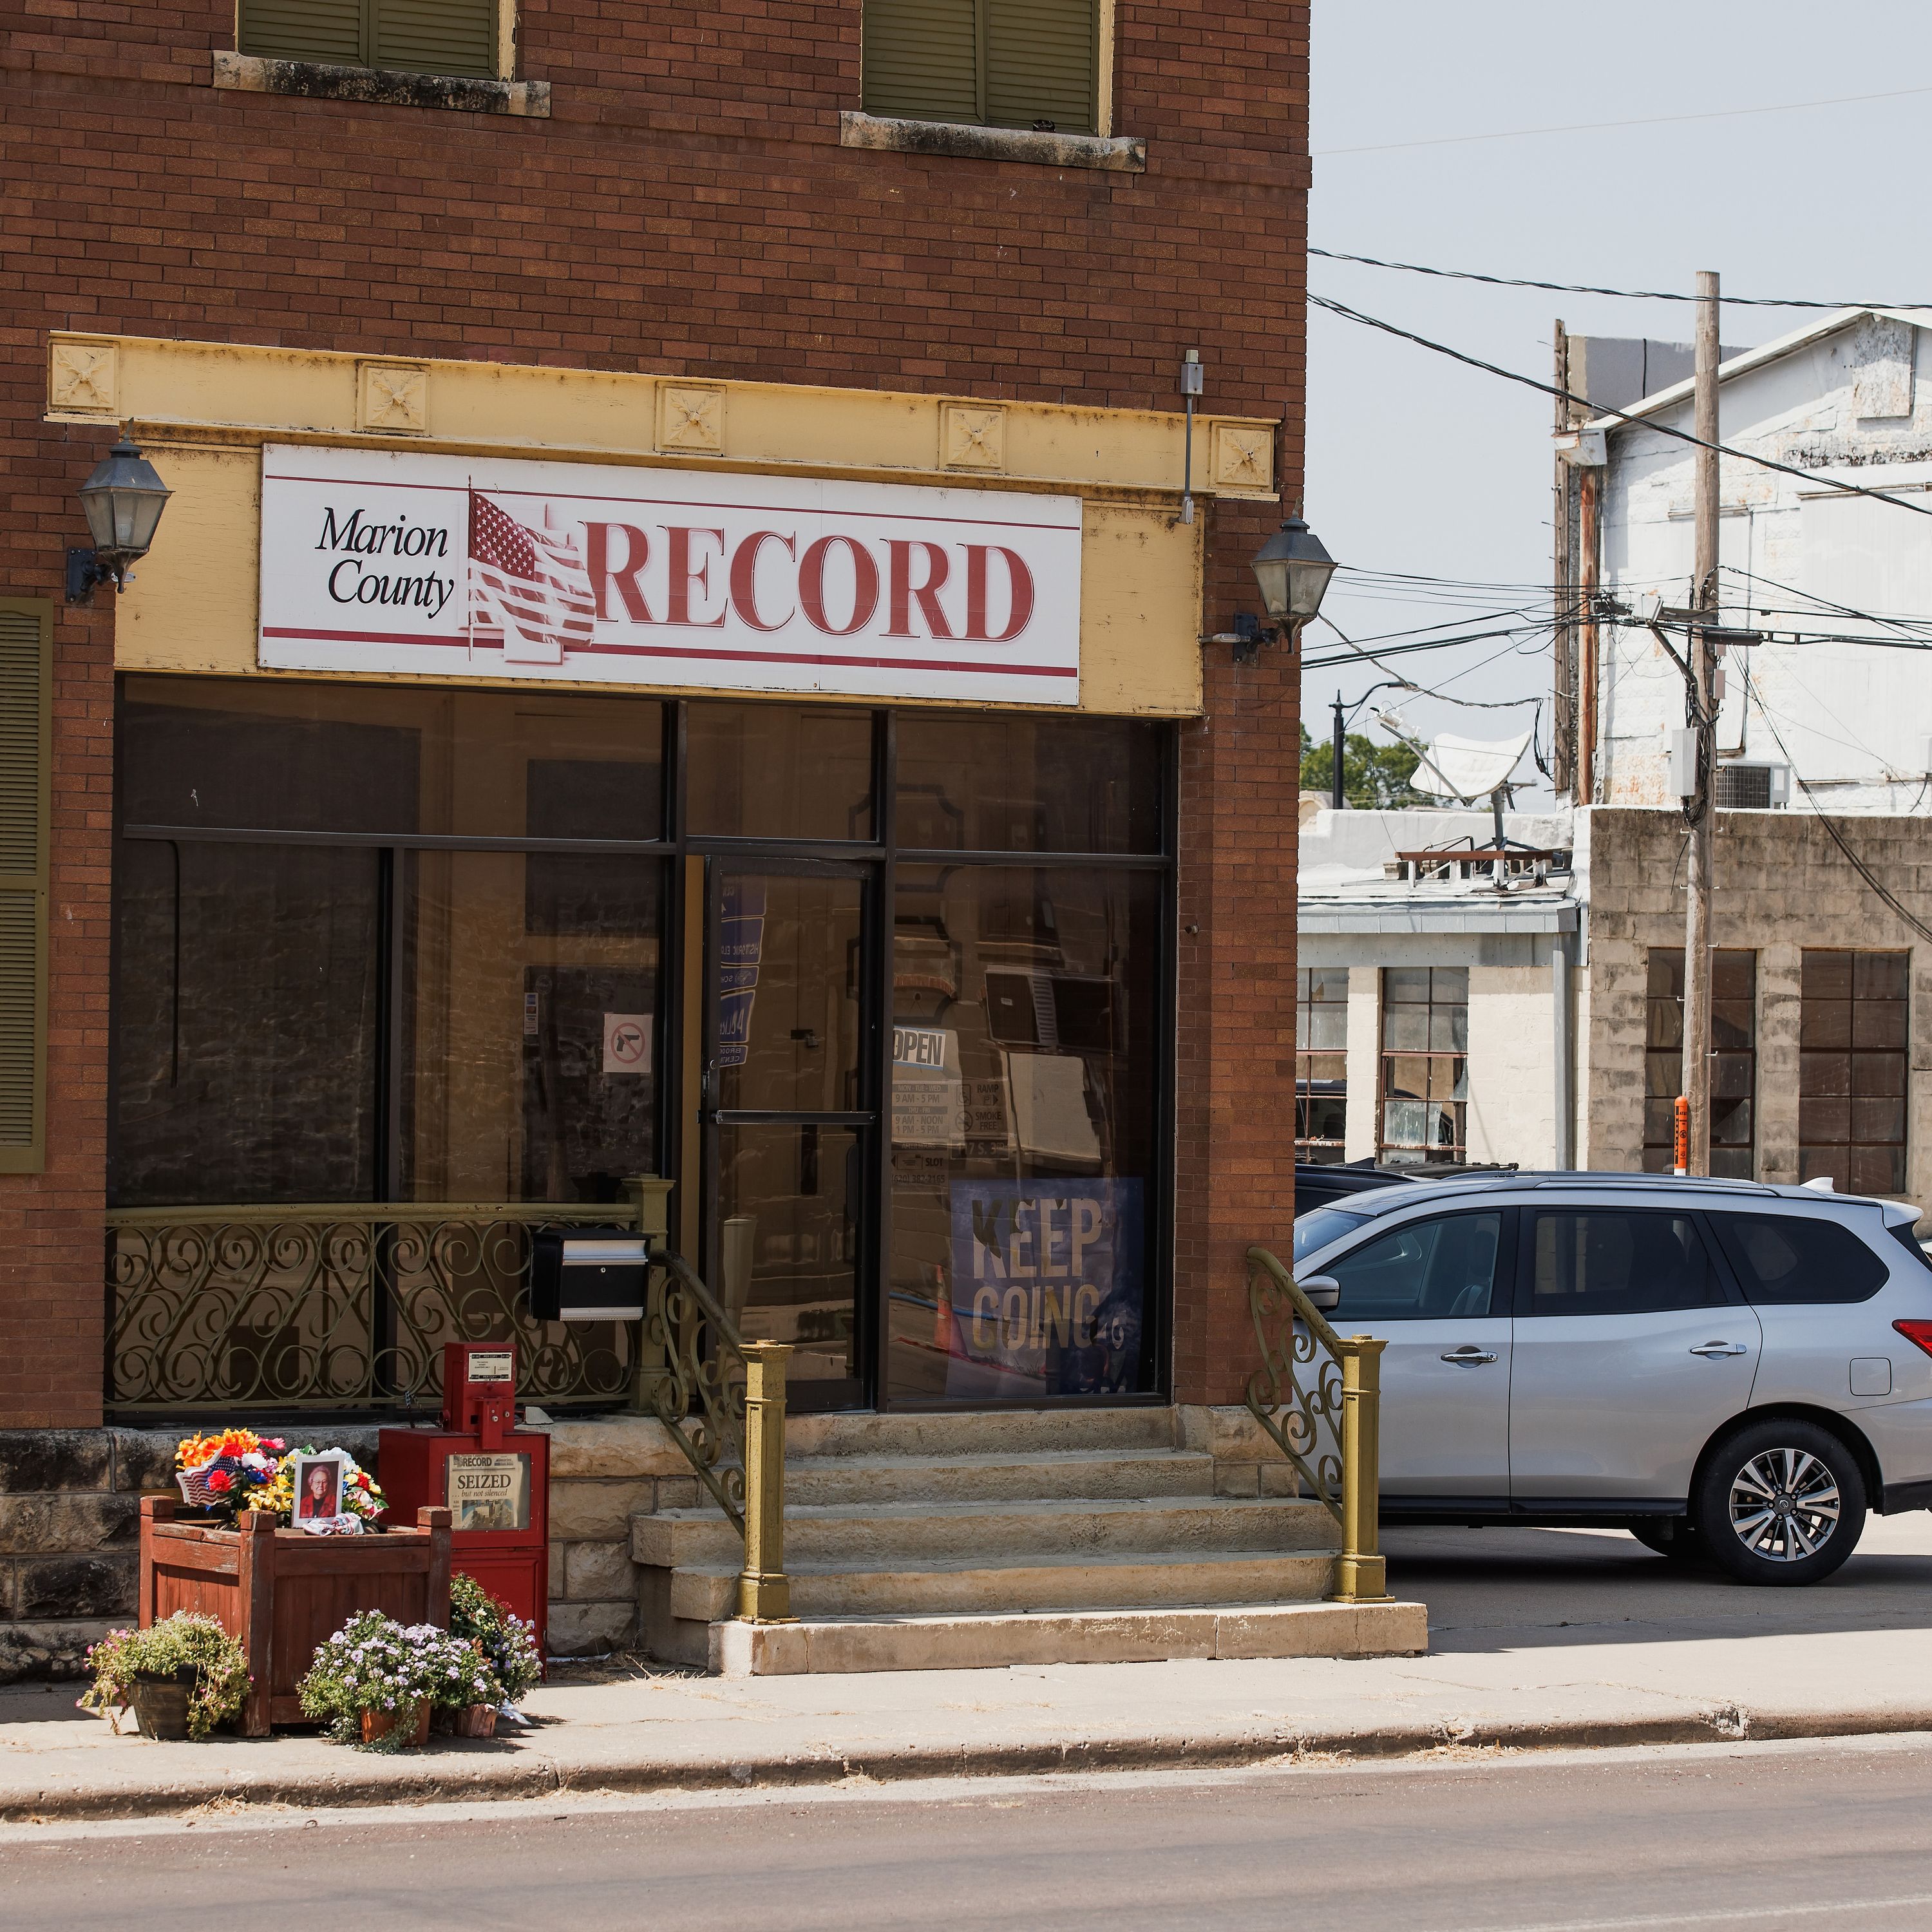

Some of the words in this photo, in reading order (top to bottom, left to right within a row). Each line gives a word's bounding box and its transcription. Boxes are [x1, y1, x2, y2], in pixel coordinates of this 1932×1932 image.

[314, 506, 449, 558] Marion
[578, 520, 1035, 642] RECORD
[328, 558, 454, 620] County
[893, 1030, 942, 1065] OPEN
[977, 1084, 999, 1093] RAMP
[895, 1094, 900, 1103] 9
[902, 1094, 914, 1103] AM
[922, 1094, 925, 1103] 5
[928, 1094, 940, 1103] PM
[902, 1116, 914, 1124] AM
[921, 1116, 943, 1124] NOON
[975, 1112, 1001, 1121] SMOKE
[927, 1126, 939, 1134] PM
[980, 1121, 997, 1130] FREE
[978, 1142, 987, 1155] S.
[925, 1157, 943, 1166] SLOT
[912, 1174, 945, 1184] 382-2165
[972, 1198, 1103, 1279] KEEP
[972, 1284, 1100, 1350] GOING
[463, 1457, 492, 1467] RECORD
[457, 1474, 511, 1490] SEIZED
